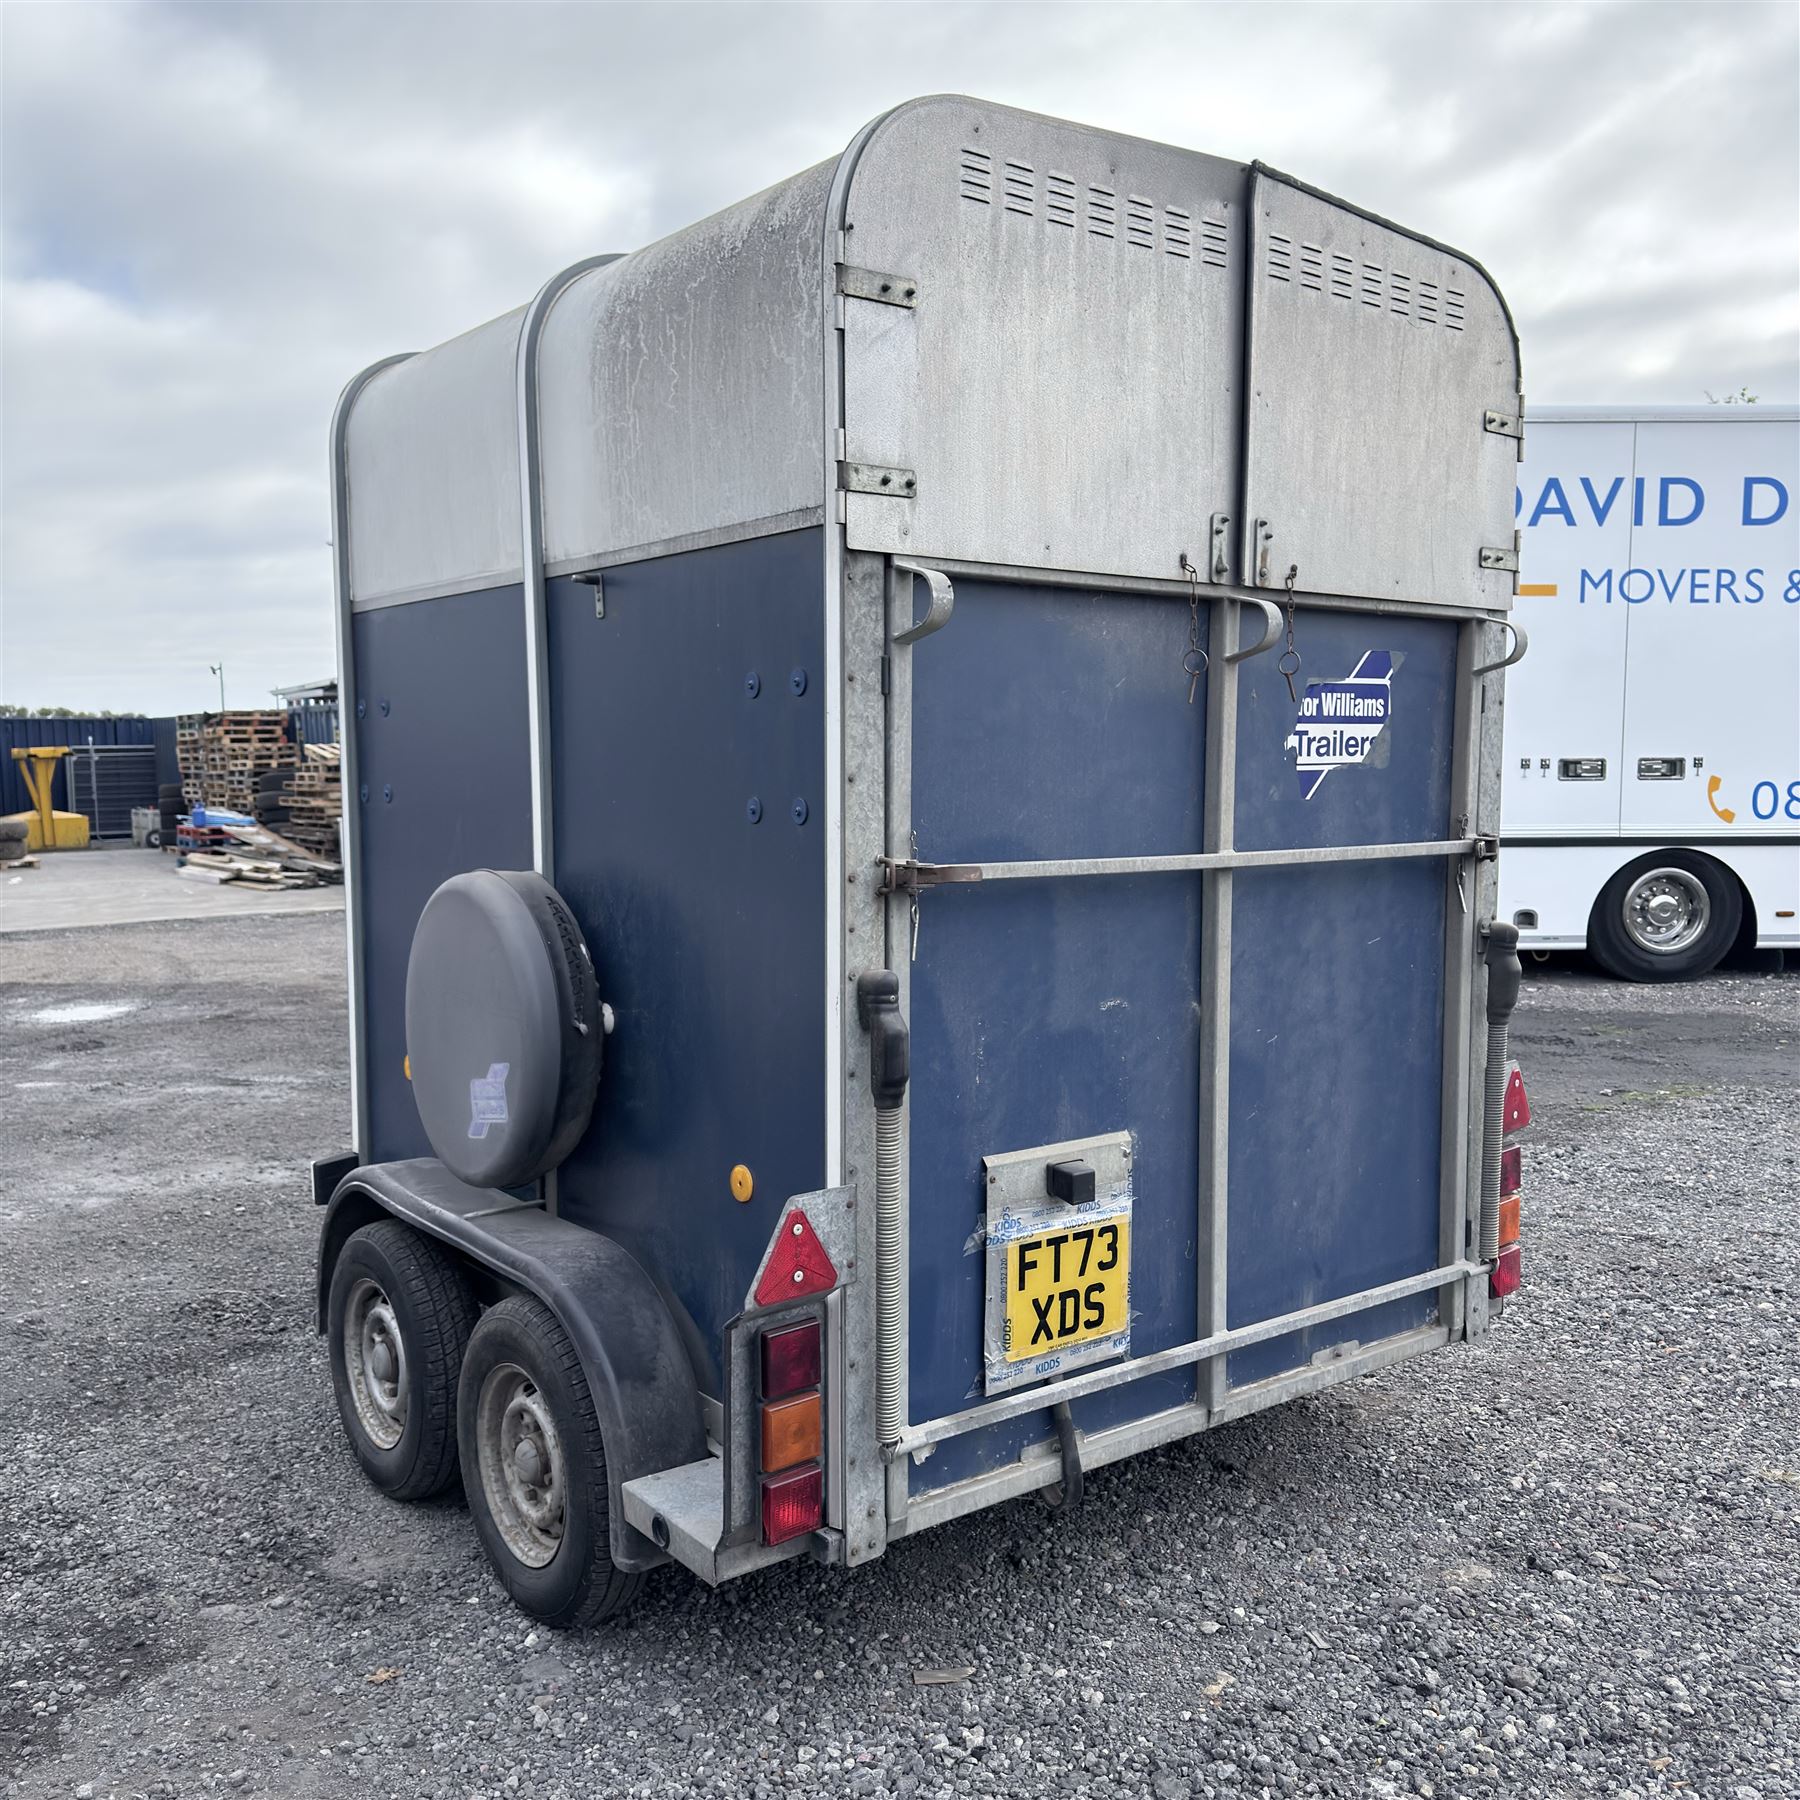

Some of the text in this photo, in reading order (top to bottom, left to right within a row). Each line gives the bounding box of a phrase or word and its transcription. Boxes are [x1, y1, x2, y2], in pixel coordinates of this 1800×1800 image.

[1516, 477, 1789, 526] AVID D
[1579, 568, 1764, 604] MOVERS
[1321, 692, 1385, 717] Williams
[1076, 1200, 1101, 1214] KIDDS
[1018, 1224, 1118, 1291] FT73
[1031, 1282, 1105, 1345] XDS
[1002, 1318, 1011, 1352] KIDDS
[1035, 1356, 1061, 1374] KIDDS
